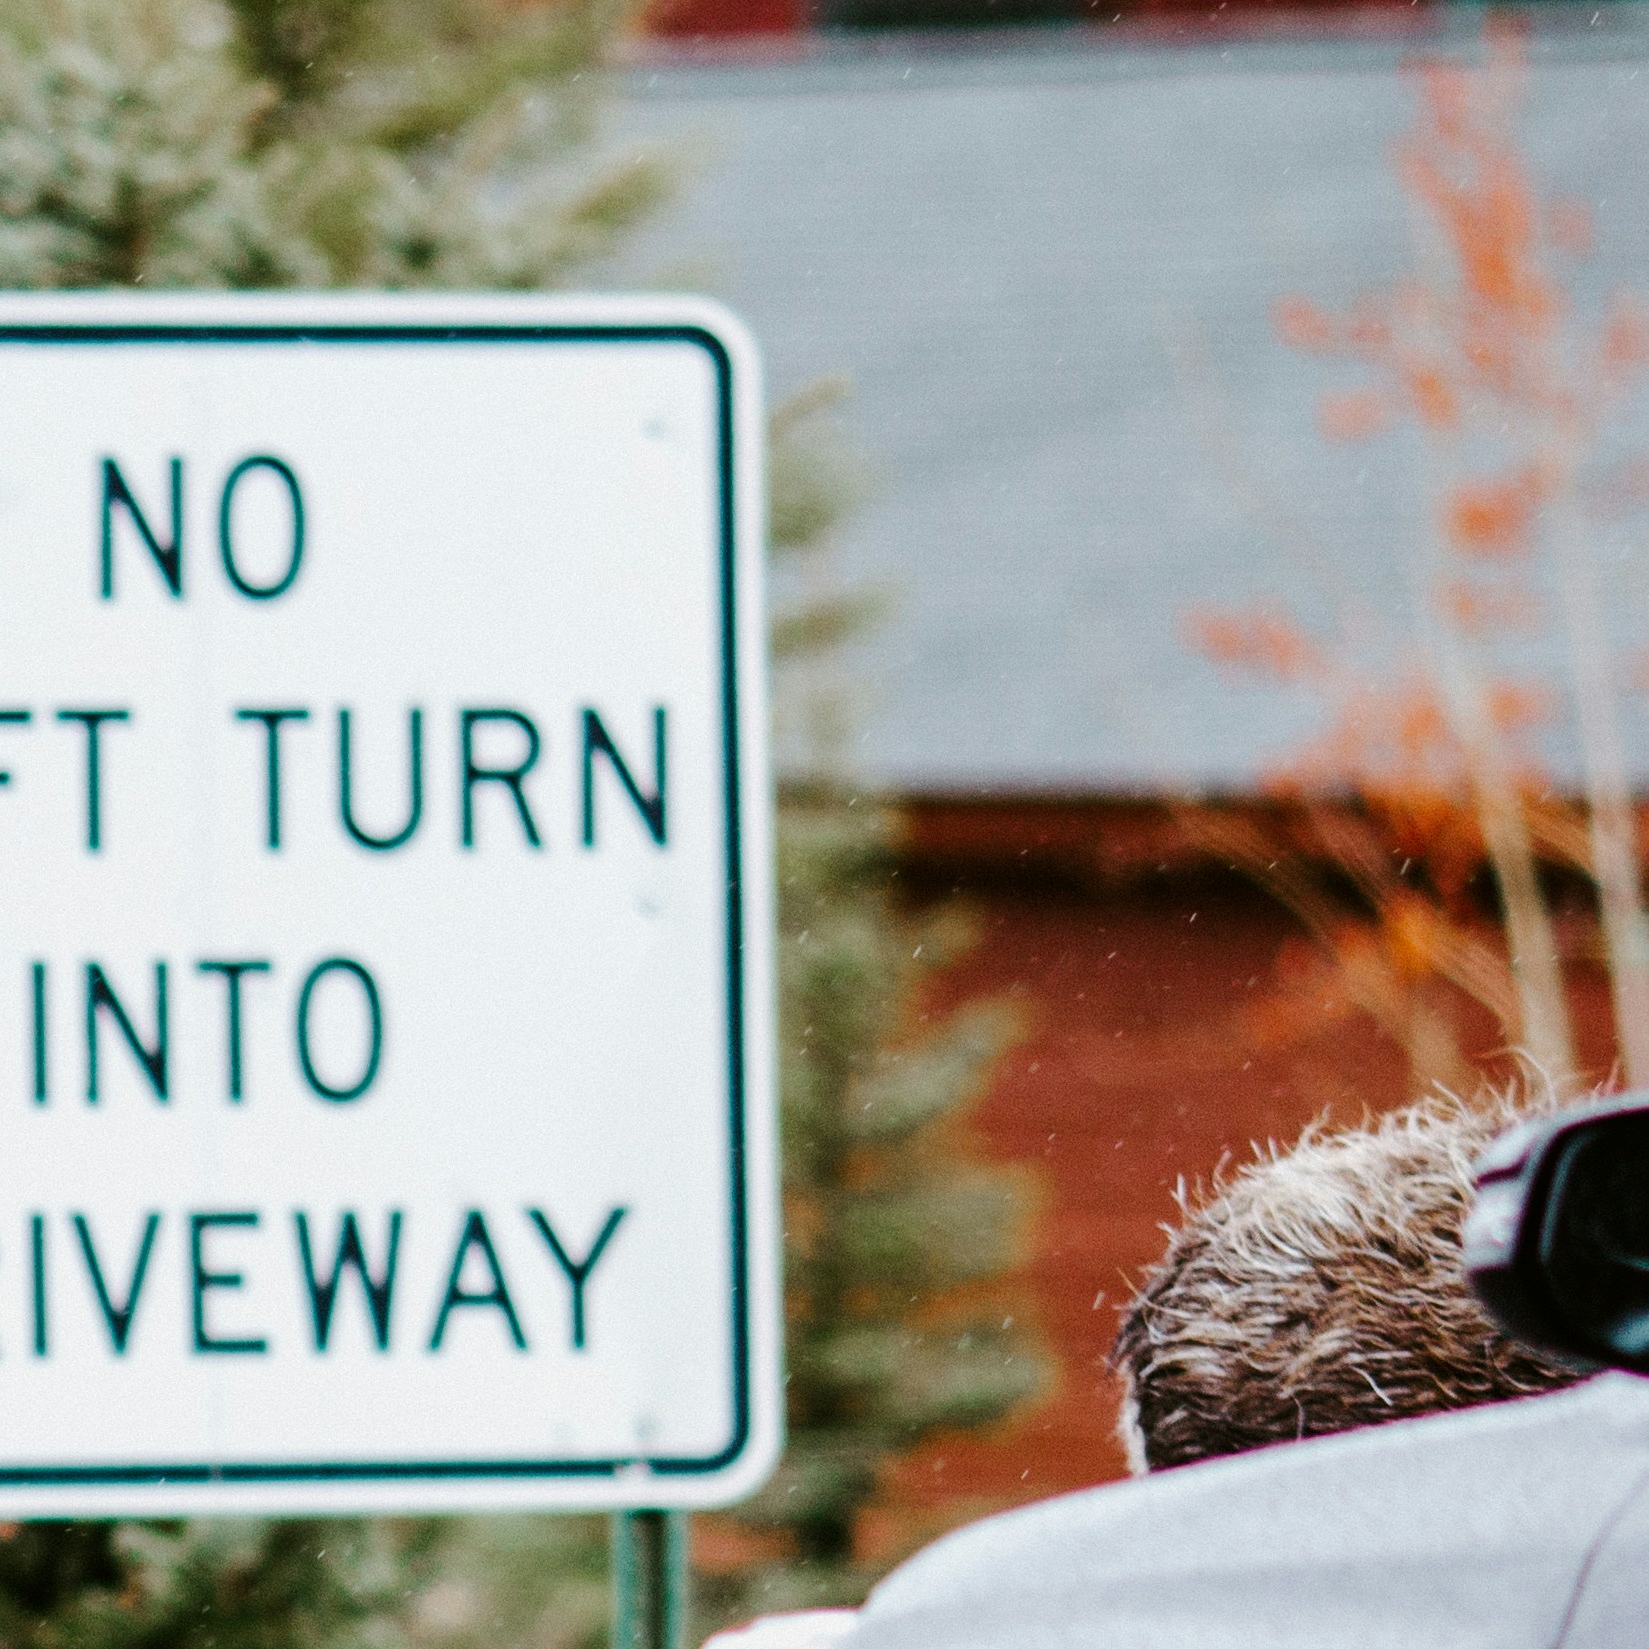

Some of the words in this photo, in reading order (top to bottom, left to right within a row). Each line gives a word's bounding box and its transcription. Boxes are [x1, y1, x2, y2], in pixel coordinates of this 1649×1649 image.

[98, 453, 308, 603] NO
[234, 706, 670, 854] TURN
[29, 955, 386, 1105] INTO
